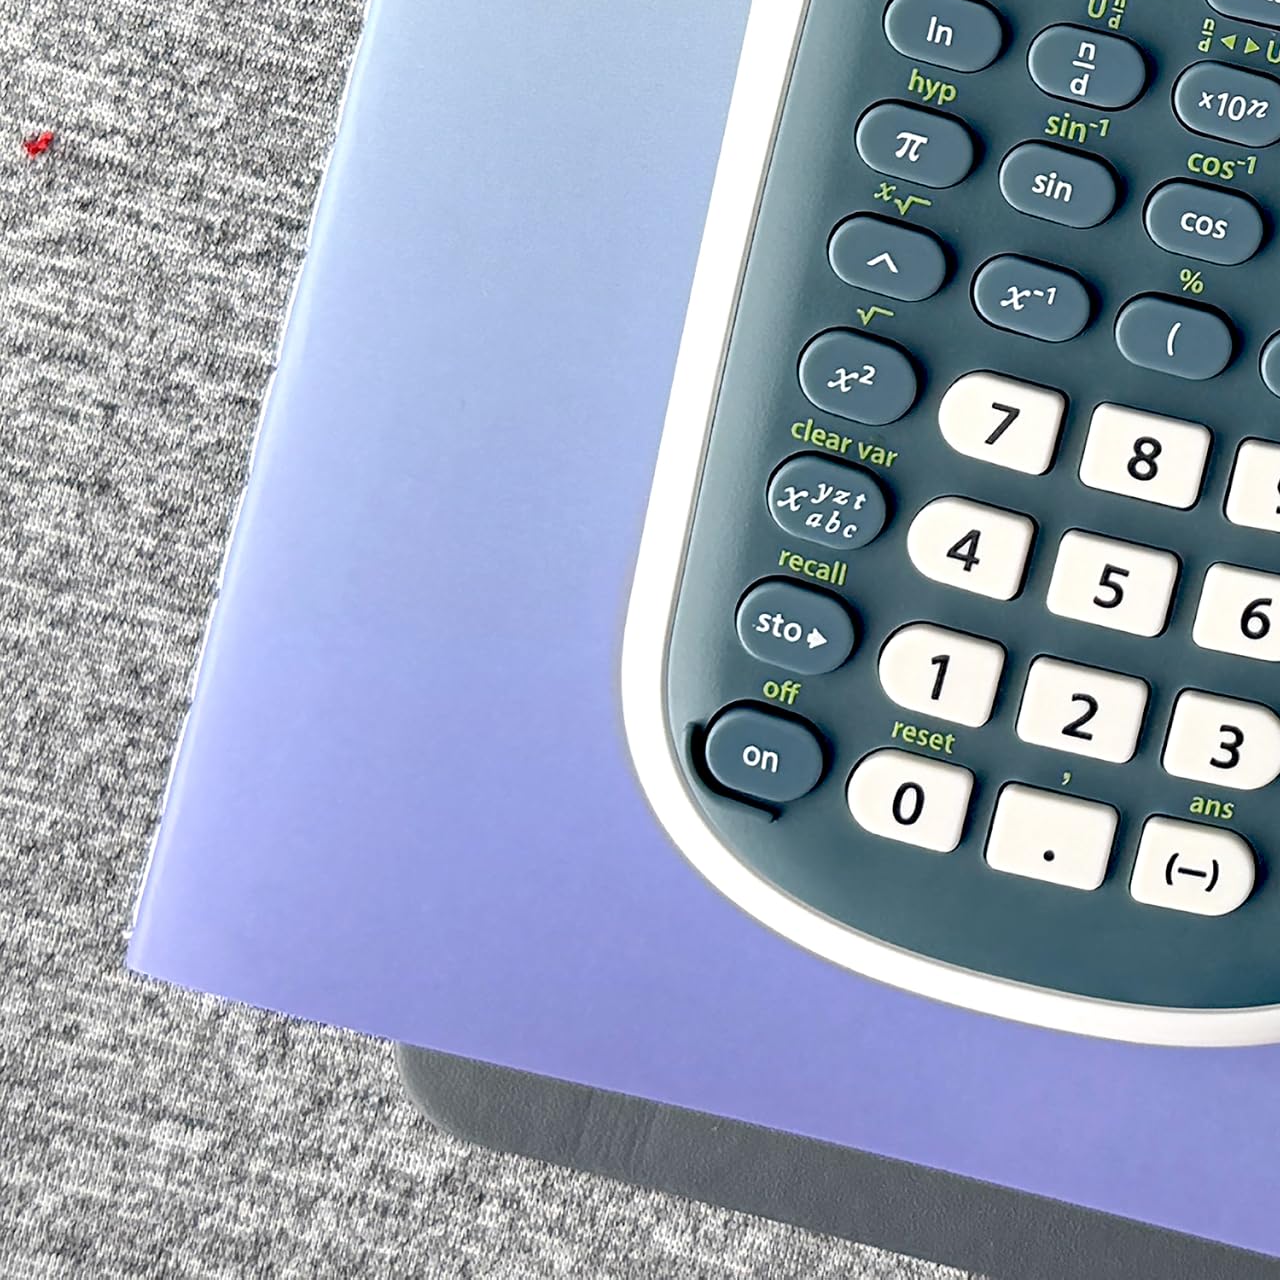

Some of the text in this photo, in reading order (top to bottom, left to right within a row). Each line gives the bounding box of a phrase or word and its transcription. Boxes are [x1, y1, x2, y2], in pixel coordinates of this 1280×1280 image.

[908, 69, 957, 105] hyp
[895, 131, 928, 162] π
[1031, 173, 1073, 203] sin
[1180, 210, 1227, 240] cos
[1179, 268, 1204, 293] %
[985, 402, 1020, 445] 7
[791, 418, 898, 468] clear var
[1126, 436, 1162, 481] 8
[778, 549, 848, 586] recall
[947, 530, 980, 572] 4
[1092, 563, 1130, 608] 5
[755, 612, 802, 642] sto
[1240, 597, 1273, 640] 6
[763, 680, 802, 705] off
[931, 655, 951, 701] 1
[1061, 692, 1099, 740] 2
[891, 721, 955, 754] reset
[1209, 725, 1244, 769] 3
[742, 743, 779, 773] on
[892, 781, 925, 826] 0
[1189, 795, 1235, 820] ans
